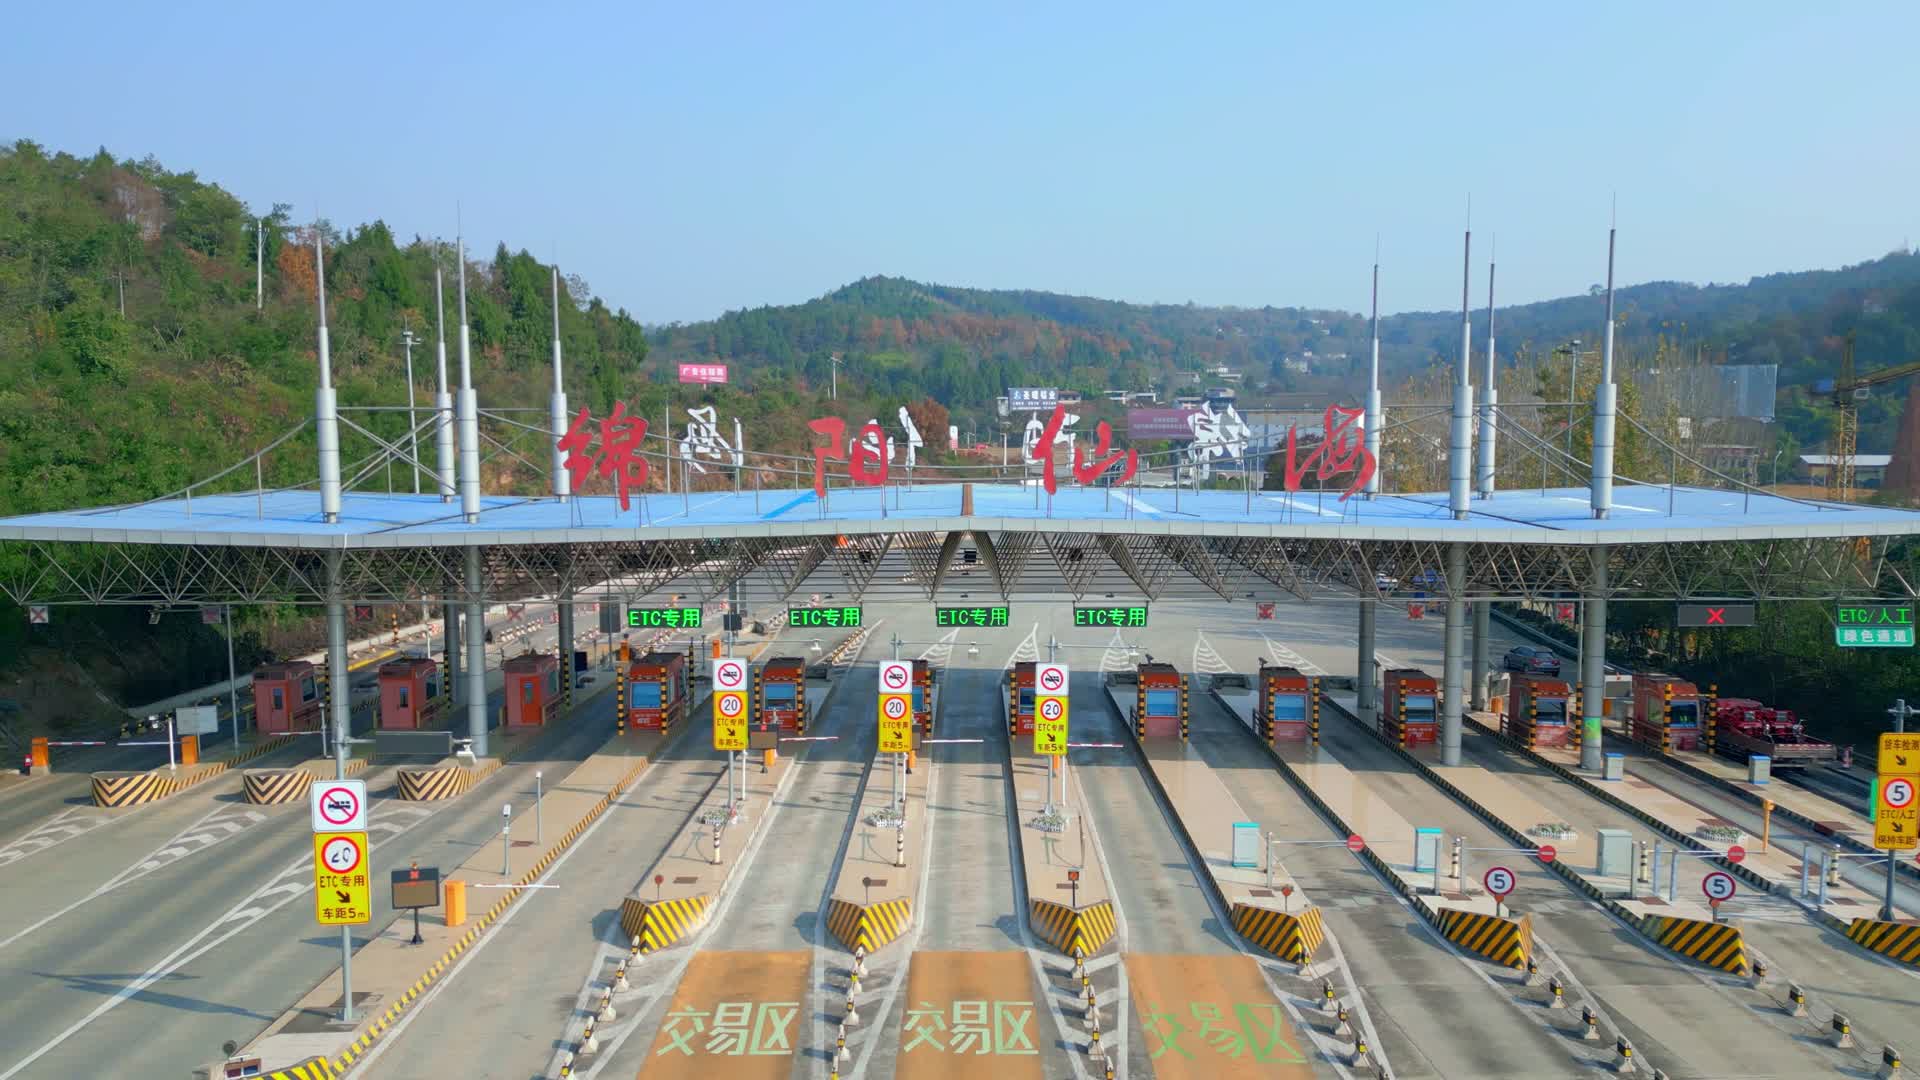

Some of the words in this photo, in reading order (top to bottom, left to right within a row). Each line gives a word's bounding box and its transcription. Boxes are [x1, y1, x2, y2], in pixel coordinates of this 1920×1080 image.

[628, 608, 701, 627] ETC专用
[790, 607, 861, 627] ETC专用
[938, 607, 1007, 626] ETC专用
[1076, 607, 1146, 626] ETC专用
[724, 699, 738, 711] 20
[889, 702, 902, 713] 20
[1045, 704, 1060, 716] 20
[1892, 785, 1905, 802] 5
[319, 875, 365, 888] ETC专用
[1494, 873, 1506, 890] 5
[1713, 878, 1726, 895] 5
[656, 1001, 799, 1057] 交易区
[903, 1001, 1040, 1056] 交易区
[1143, 1000, 1310, 1066] 交易区
